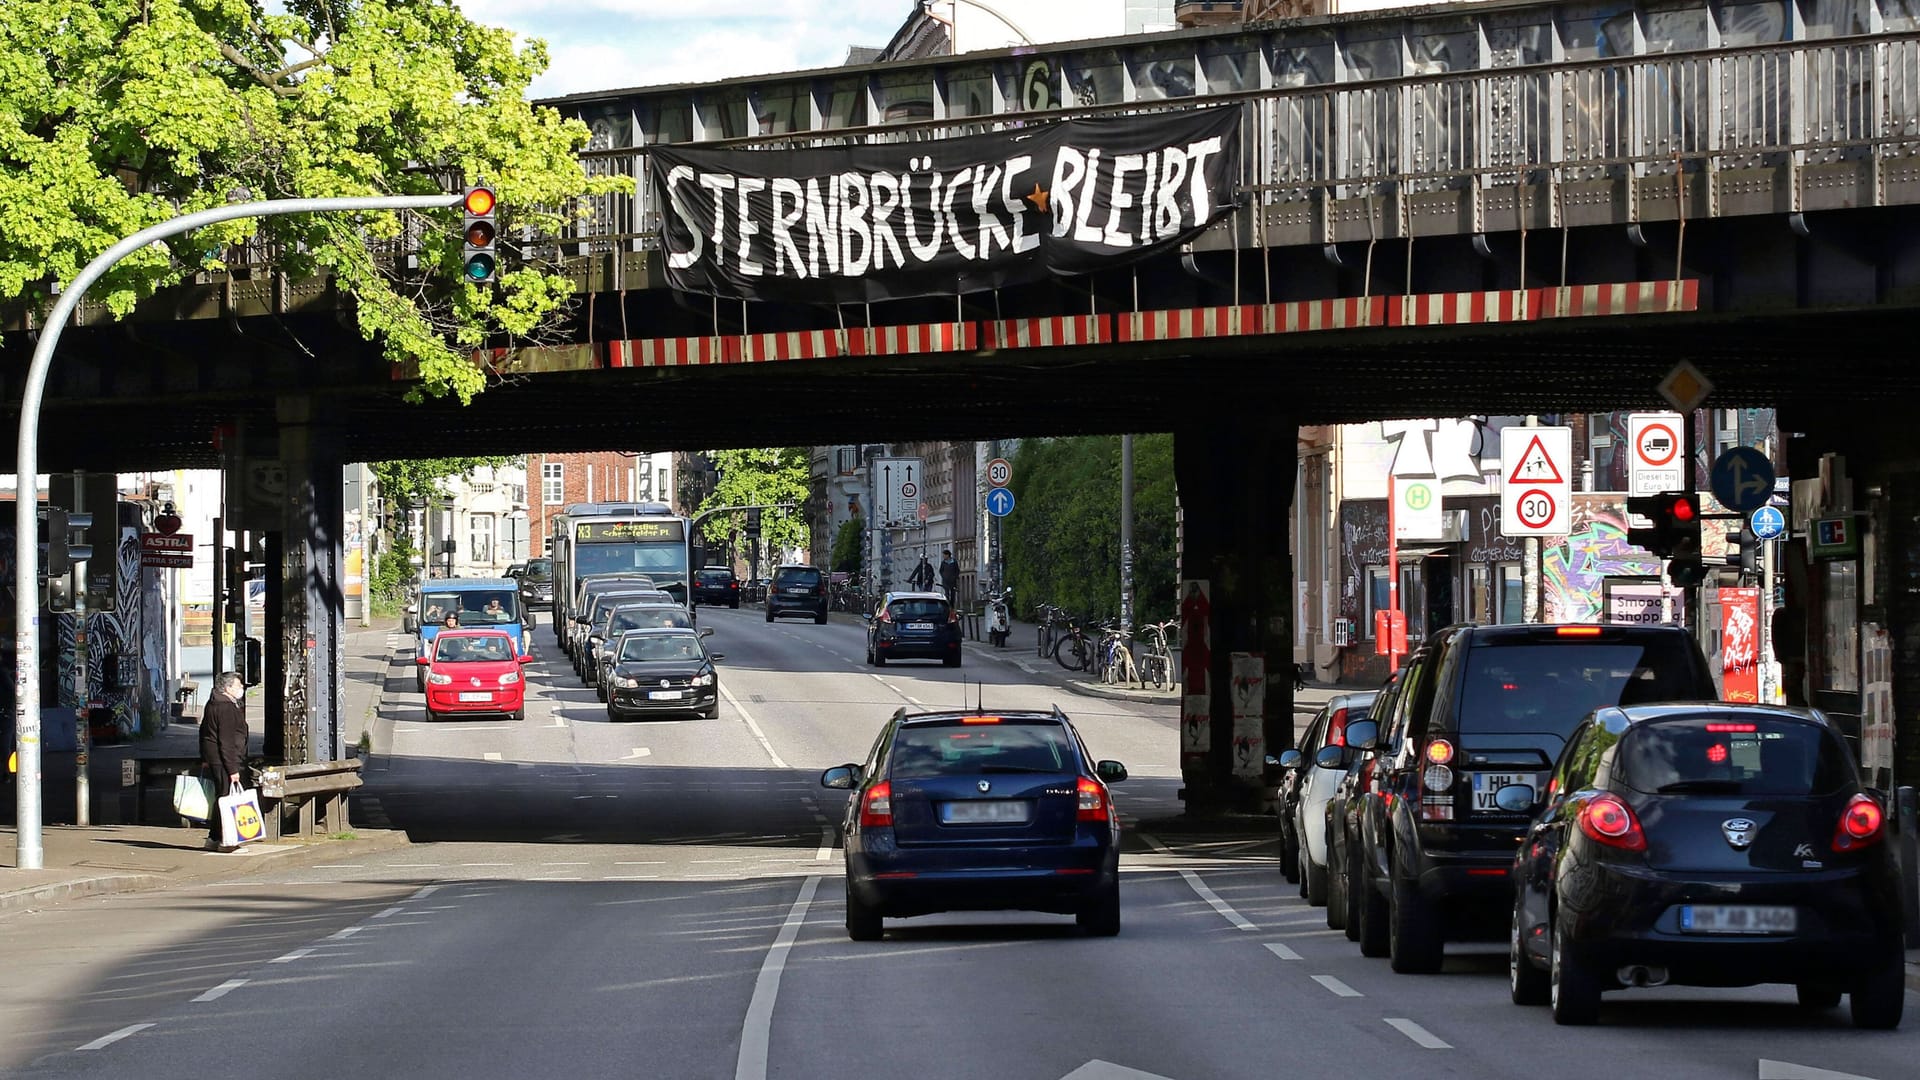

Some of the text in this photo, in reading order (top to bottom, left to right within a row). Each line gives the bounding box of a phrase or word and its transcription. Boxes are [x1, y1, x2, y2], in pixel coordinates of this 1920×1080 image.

[667, 136, 1222, 279] STERNBRÜCKE BLEIBT
[992, 466, 1006, 479] 30
[1638, 473, 1662, 481] Diesel
[1525, 500, 1547, 518] 30
[578, 525, 591, 538] X3
[145, 537, 189, 547] ASTRA
[142, 557, 167, 565] ASTRA
[1618, 611, 1681, 624] Shoppg
[1489, 775, 1511, 791] HH
